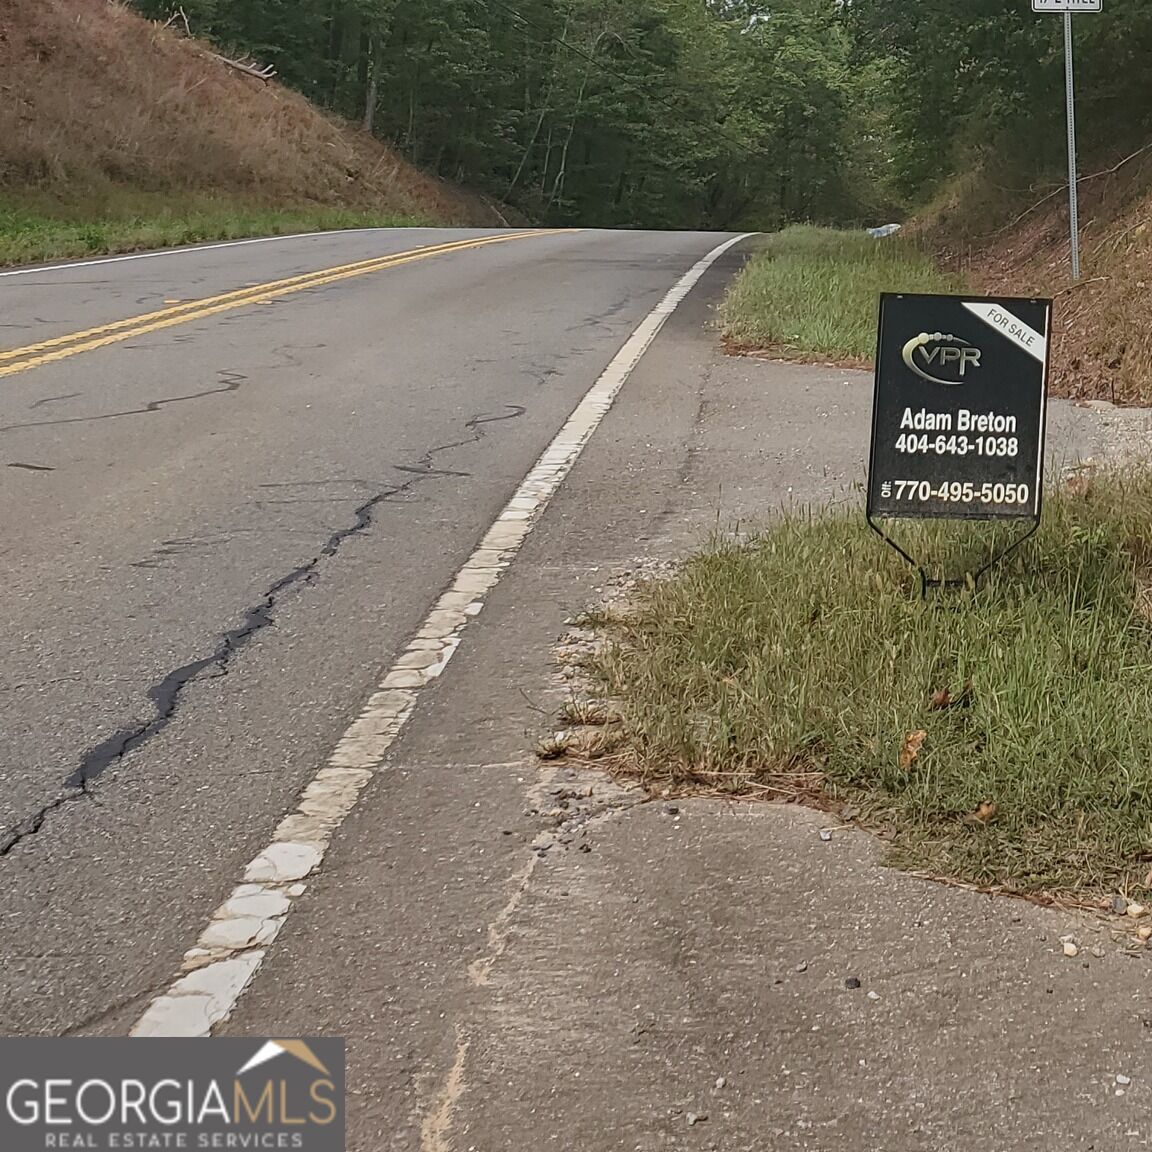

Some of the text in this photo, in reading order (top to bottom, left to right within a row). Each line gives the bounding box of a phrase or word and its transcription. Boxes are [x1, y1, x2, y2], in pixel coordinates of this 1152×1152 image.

[987, 308, 1036, 347] FOR SALE
[918, 347, 981, 376] VPR
[900, 407, 1016, 433] Adam Breton
[895, 433, 1018, 457] 404-643-1038
[894, 480, 1029, 504] 770-495-5050
